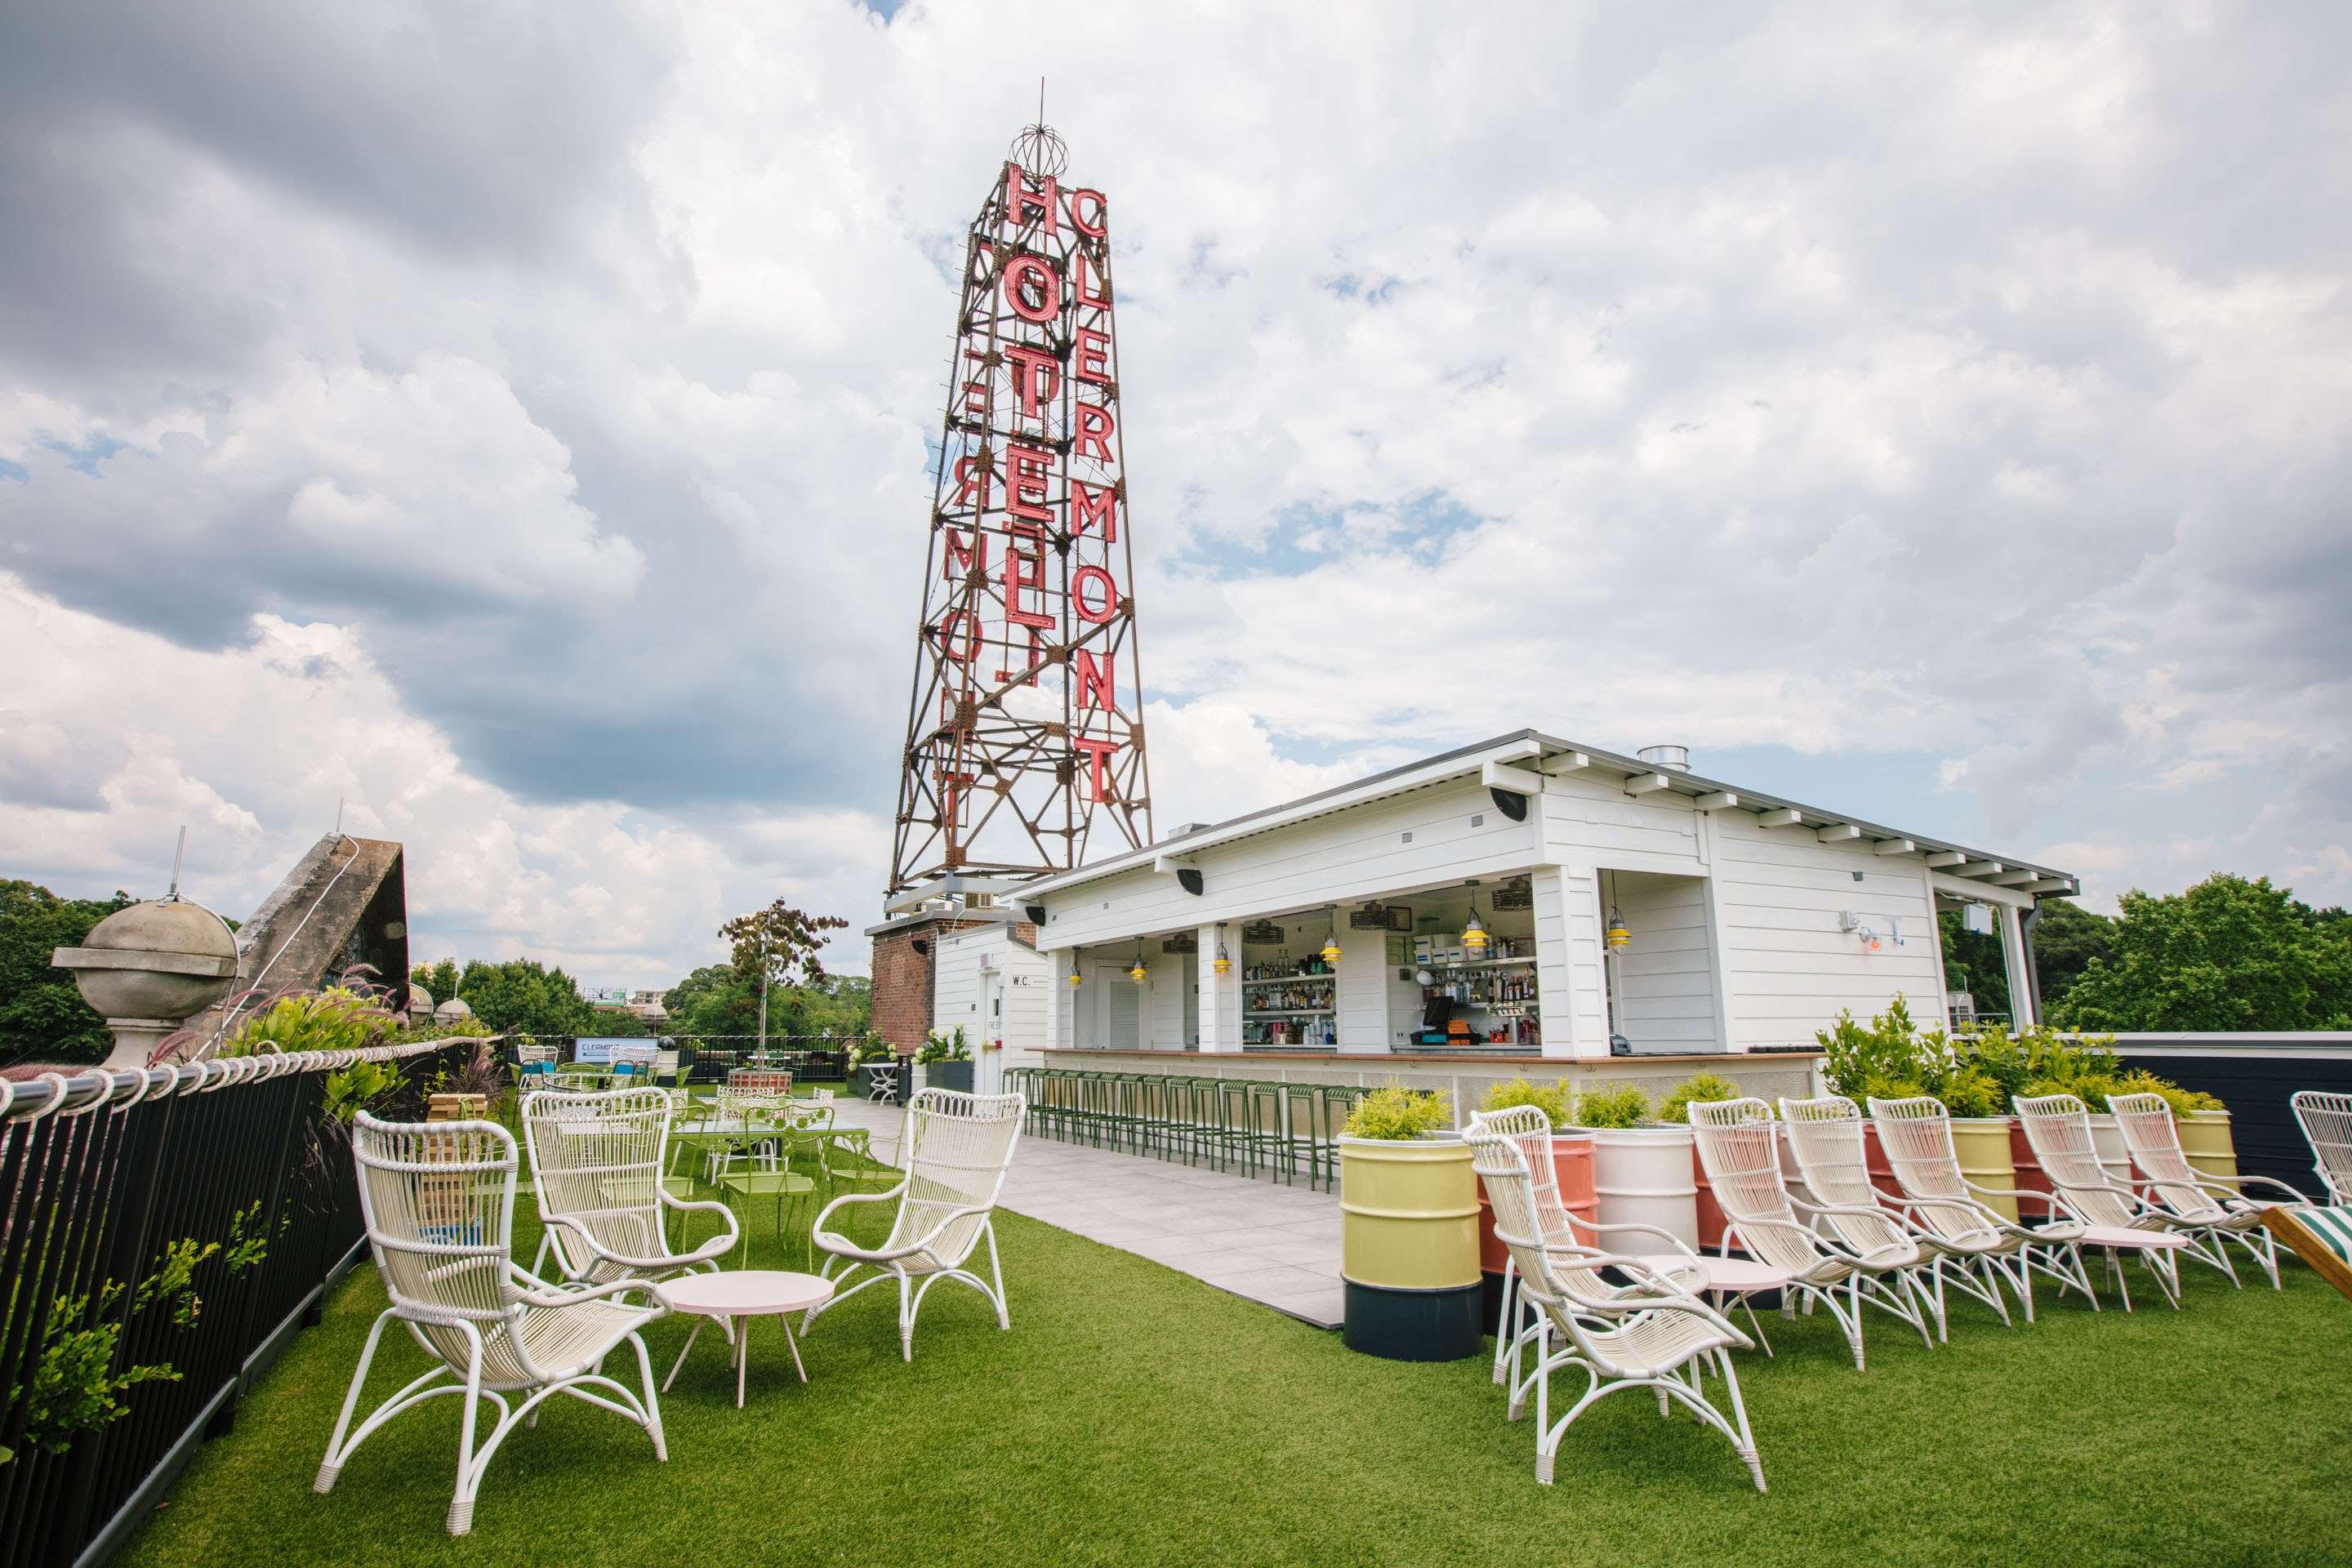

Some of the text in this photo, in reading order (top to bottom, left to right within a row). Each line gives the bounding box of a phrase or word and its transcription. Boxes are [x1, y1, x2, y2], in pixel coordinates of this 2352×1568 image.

[1004, 163, 1059, 630] HOTEL
[1070, 187, 1120, 804] CLERMONT
[1013, 976, 1031, 987] W.C.
